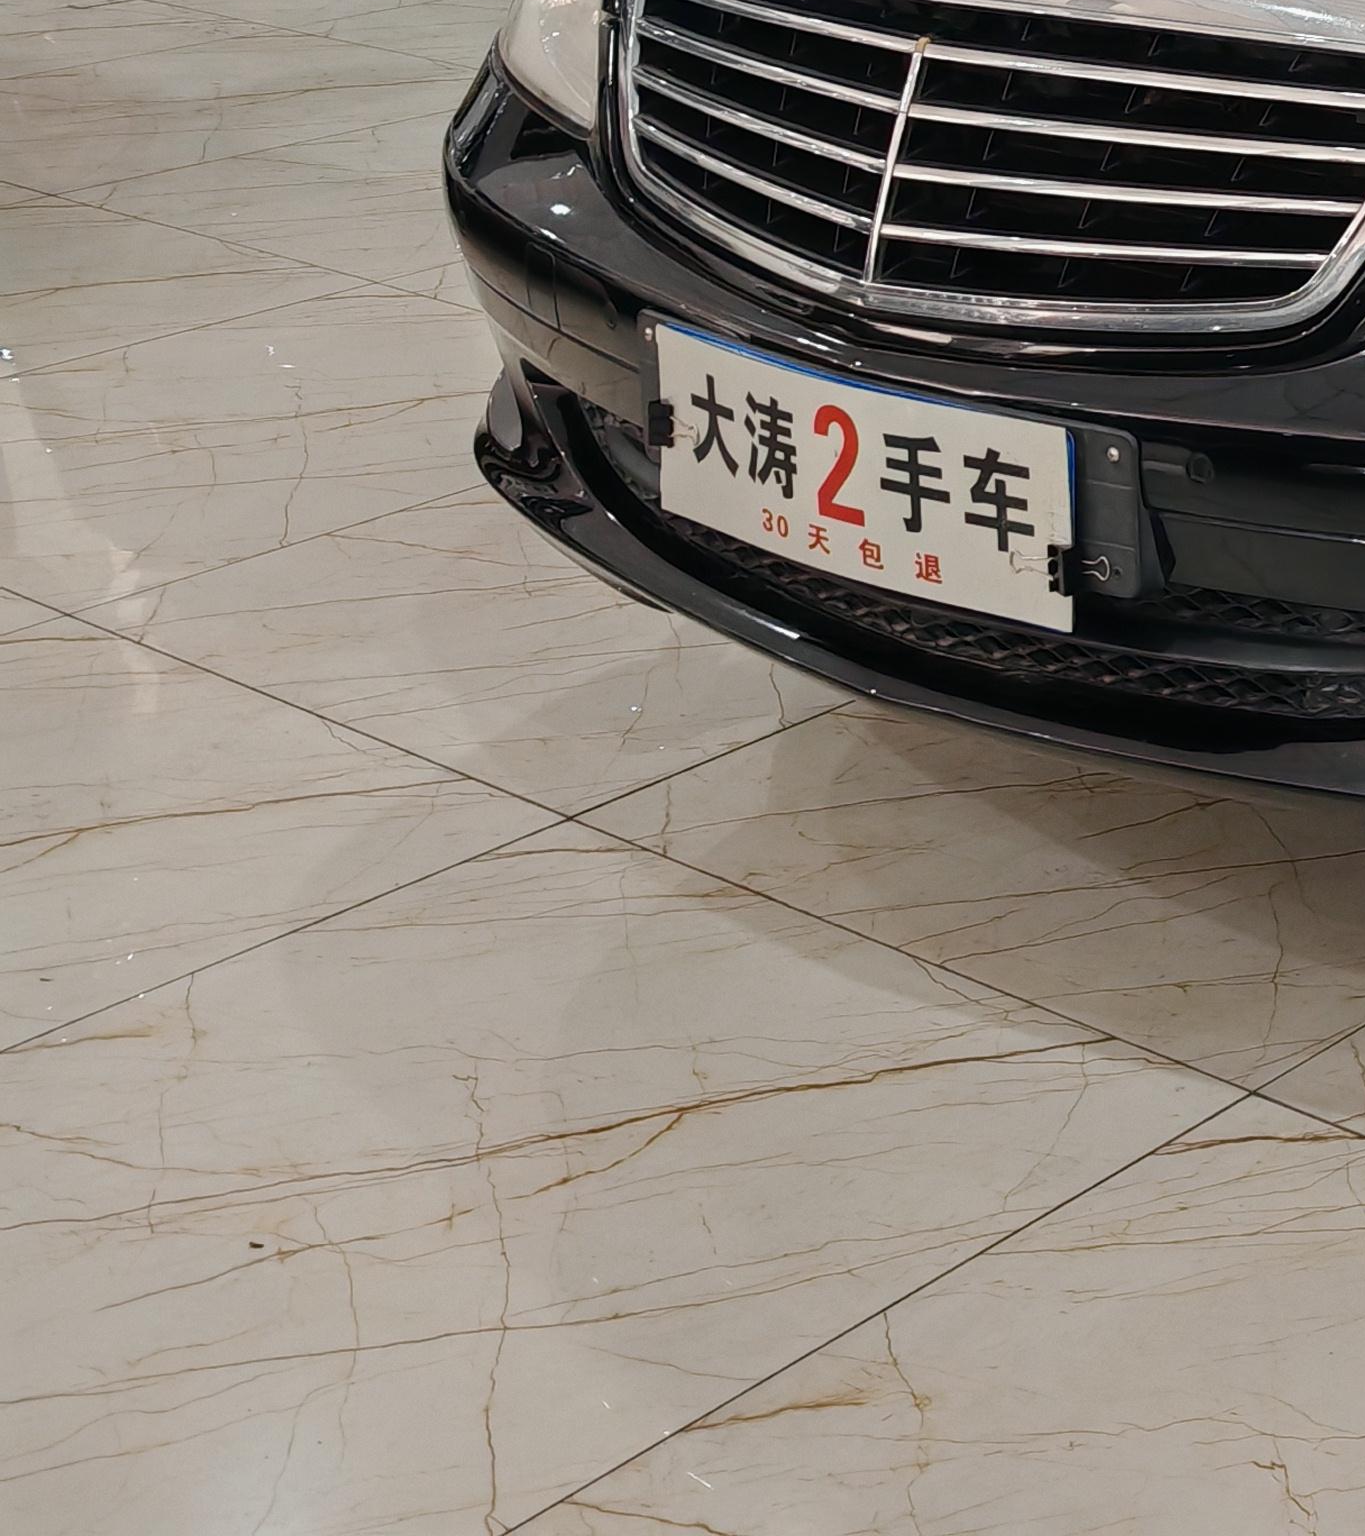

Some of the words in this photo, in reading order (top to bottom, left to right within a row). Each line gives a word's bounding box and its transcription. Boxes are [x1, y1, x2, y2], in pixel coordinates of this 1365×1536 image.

[690, 373, 1035, 552] 大涛2手车
[761, 508, 943, 585] 30天包退
